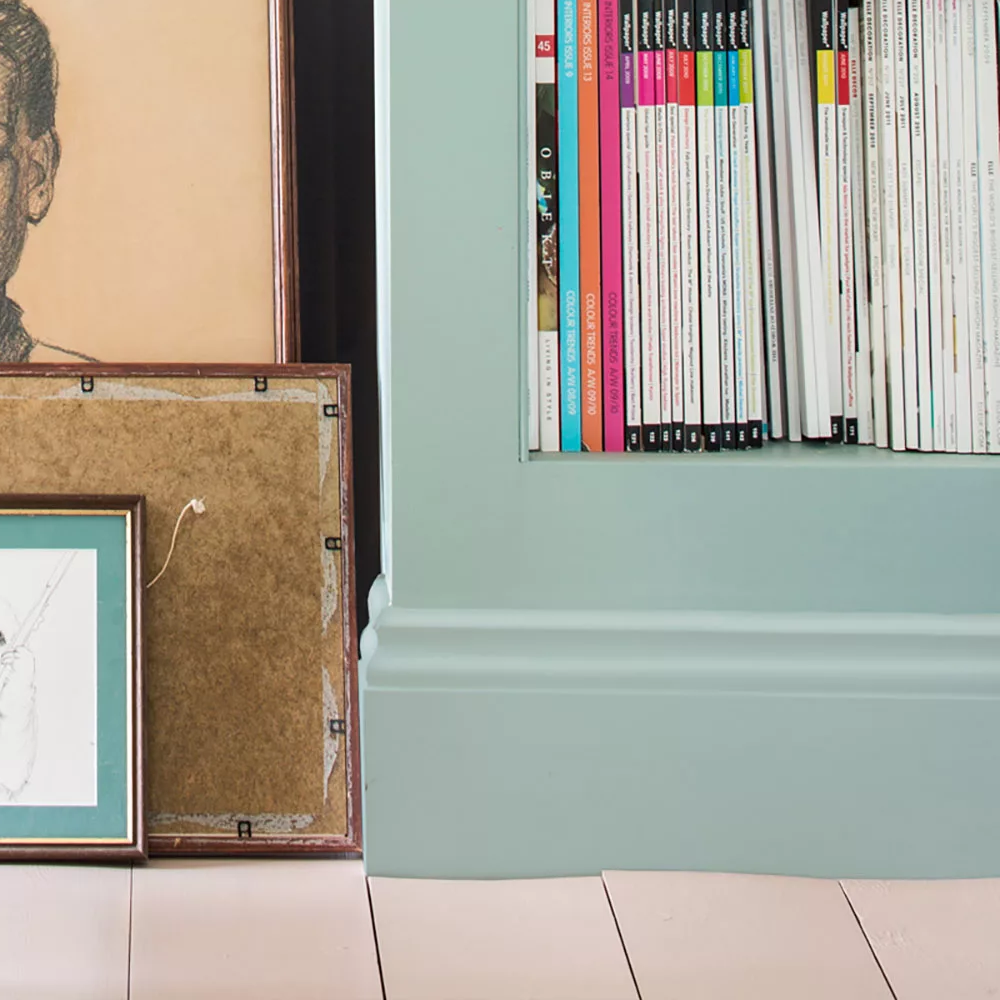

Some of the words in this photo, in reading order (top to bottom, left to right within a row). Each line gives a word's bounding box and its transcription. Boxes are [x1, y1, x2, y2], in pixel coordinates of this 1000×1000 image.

[563, 1, 574, 44] INTERIORS
[582, 2, 592, 45] INTERIORS
[603, 1, 613, 43] INTERIORS
[537, 40, 550, 51] 45
[564, 46, 574, 68] ISSUE
[582, 47, 592, 69] ISSUE
[604, 46, 614, 68] ISSUE
[582, 72, 592, 82] 13
[604, 71, 614, 80] 14
[566, 290, 575, 326] COLOUR
[586, 294, 596, 330] COLOUR
[608, 292, 618, 328] COLOUR
[566, 330, 576, 362] TRENDS
[586, 332, 596, 364] TRENDS
[608, 330, 618, 363] TRENDS
[546, 376, 552, 386] IN
[567, 366, 576, 386] A/W
[587, 369, 596, 388] A/W
[608, 368, 618, 387] A/W
[586, 390, 597, 416] 09/10
[608, 388, 619, 414] 09/10
